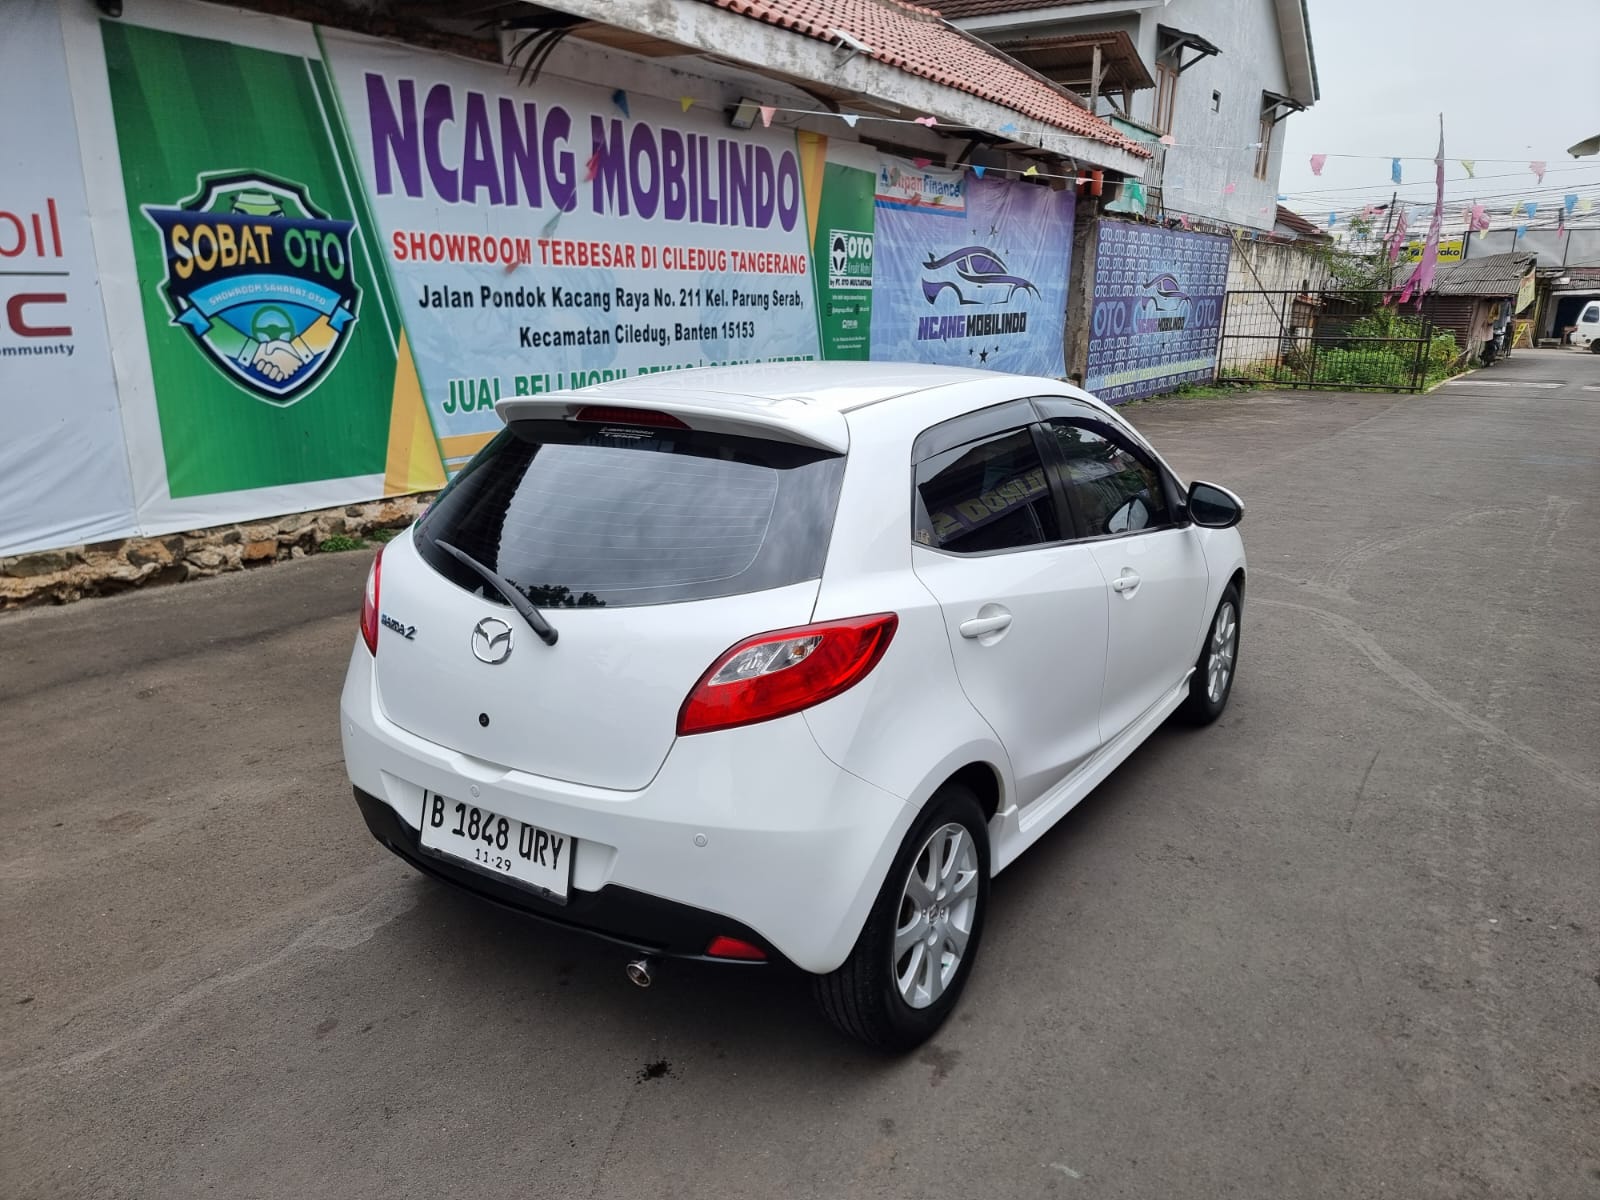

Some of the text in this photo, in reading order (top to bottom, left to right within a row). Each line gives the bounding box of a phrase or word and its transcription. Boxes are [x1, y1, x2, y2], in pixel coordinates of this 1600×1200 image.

[365, 73, 799, 232] NCANG MOBILINDO
[924, 174, 961, 198] Finance
[172, 224, 345, 280] SOBAT OTO
[393, 232, 806, 274] SHOWROOM TERBESAR DI CILEDUG TANGERANG
[848, 236, 873, 259] OTO
[419, 285, 803, 312] Jalan Pondok Kacang Raya No. 211 Kel. Parung Serab,
[519, 321, 755, 348] Kecamatan Ciledug, Banten 15153
[918, 312, 1027, 342] NCANG MOBILINDO
[405, 625, 416, 640] 2
[430, 794, 564, 871] B 1848 URY
